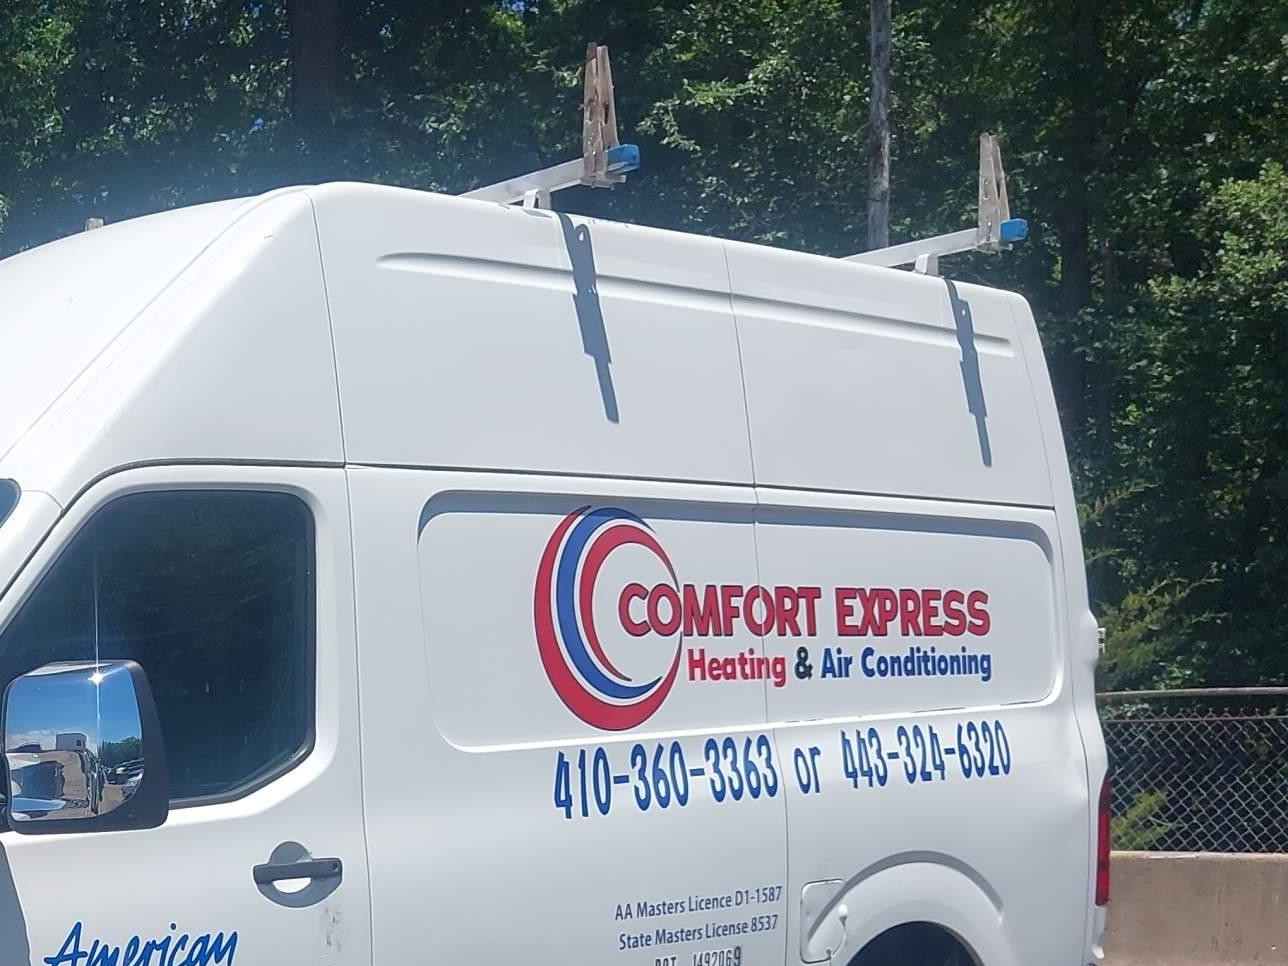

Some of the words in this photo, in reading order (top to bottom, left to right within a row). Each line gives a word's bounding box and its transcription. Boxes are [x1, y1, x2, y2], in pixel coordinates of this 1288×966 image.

[619, 583, 821, 637] COMFORT
[835, 588, 991, 636] EXPRESS
[688, 648, 786, 687] Heating
[795, 646, 813, 681] &
[821, 648, 854, 679] Air
[862, 645, 992, 682] Conditioning
[553, 735, 779, 820] 410-360-3363
[794, 746, 821, 794] or
[841, 719, 1012, 790] 443-324-6320
[615, 904, 633, 921] AA
[637, 899, 685, 918] Masters
[689, 895, 732, 912] Licence
[735, 886, 782, 905] D1-1587
[619, 932, 652, 950] State
[655, 926, 703, 945] Masters
[706, 921, 748, 939] License
[751, 914, 779, 932] 8537
